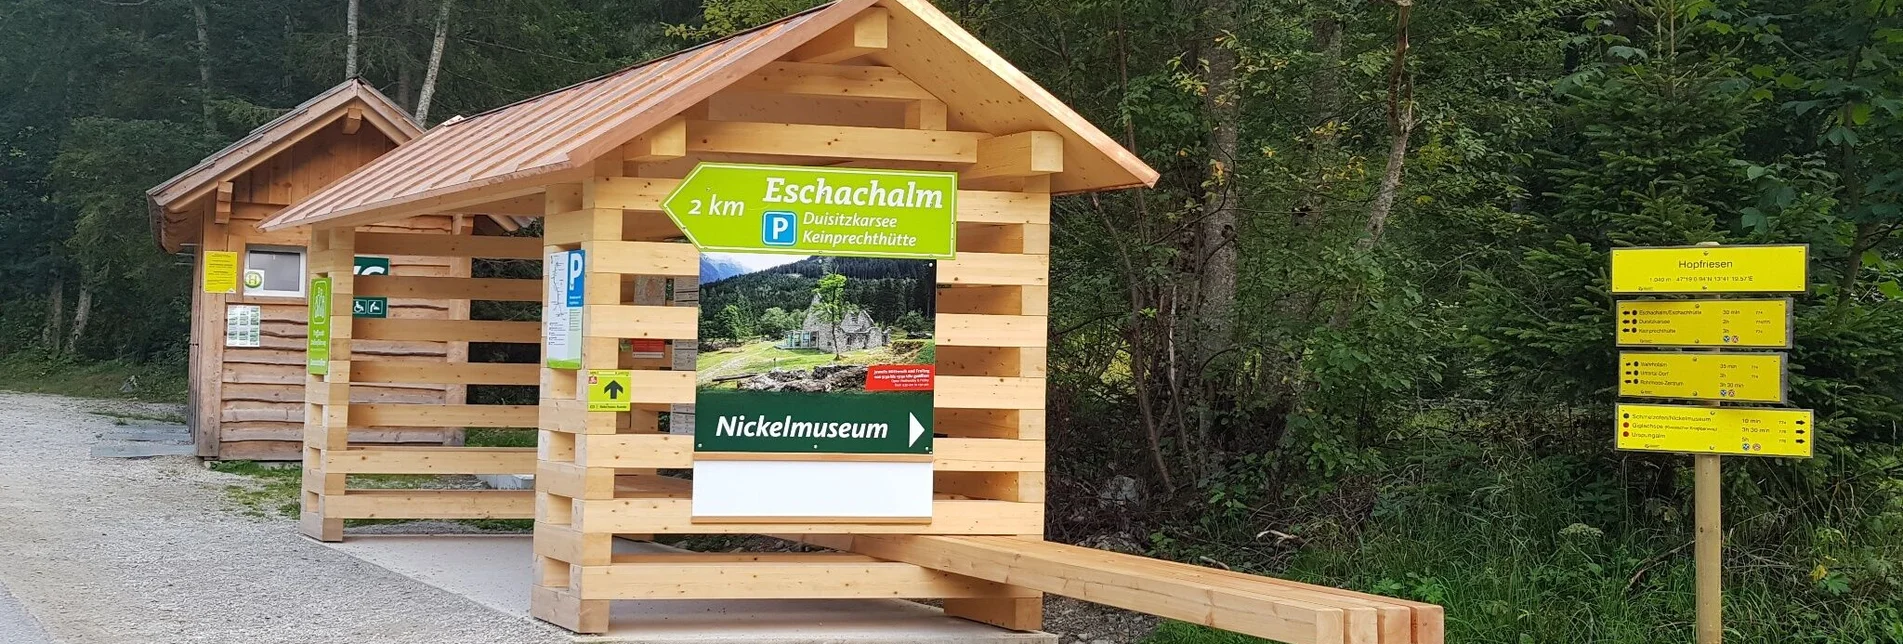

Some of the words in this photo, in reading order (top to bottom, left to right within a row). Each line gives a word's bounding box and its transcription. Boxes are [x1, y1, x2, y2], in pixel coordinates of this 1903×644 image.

[763, 177, 943, 209] Eschachalm
[688, 199, 702, 215] 2
[708, 195, 745, 217] km
[771, 217, 789, 240] P
[803, 212, 898, 229] Duisitzkarsee
[802, 230, 917, 248] Keinprechthütte
[569, 252, 583, 291] P
[1678, 260, 1733, 270] Hopfriesen
[716, 415, 889, 439] Nickelmuseum
